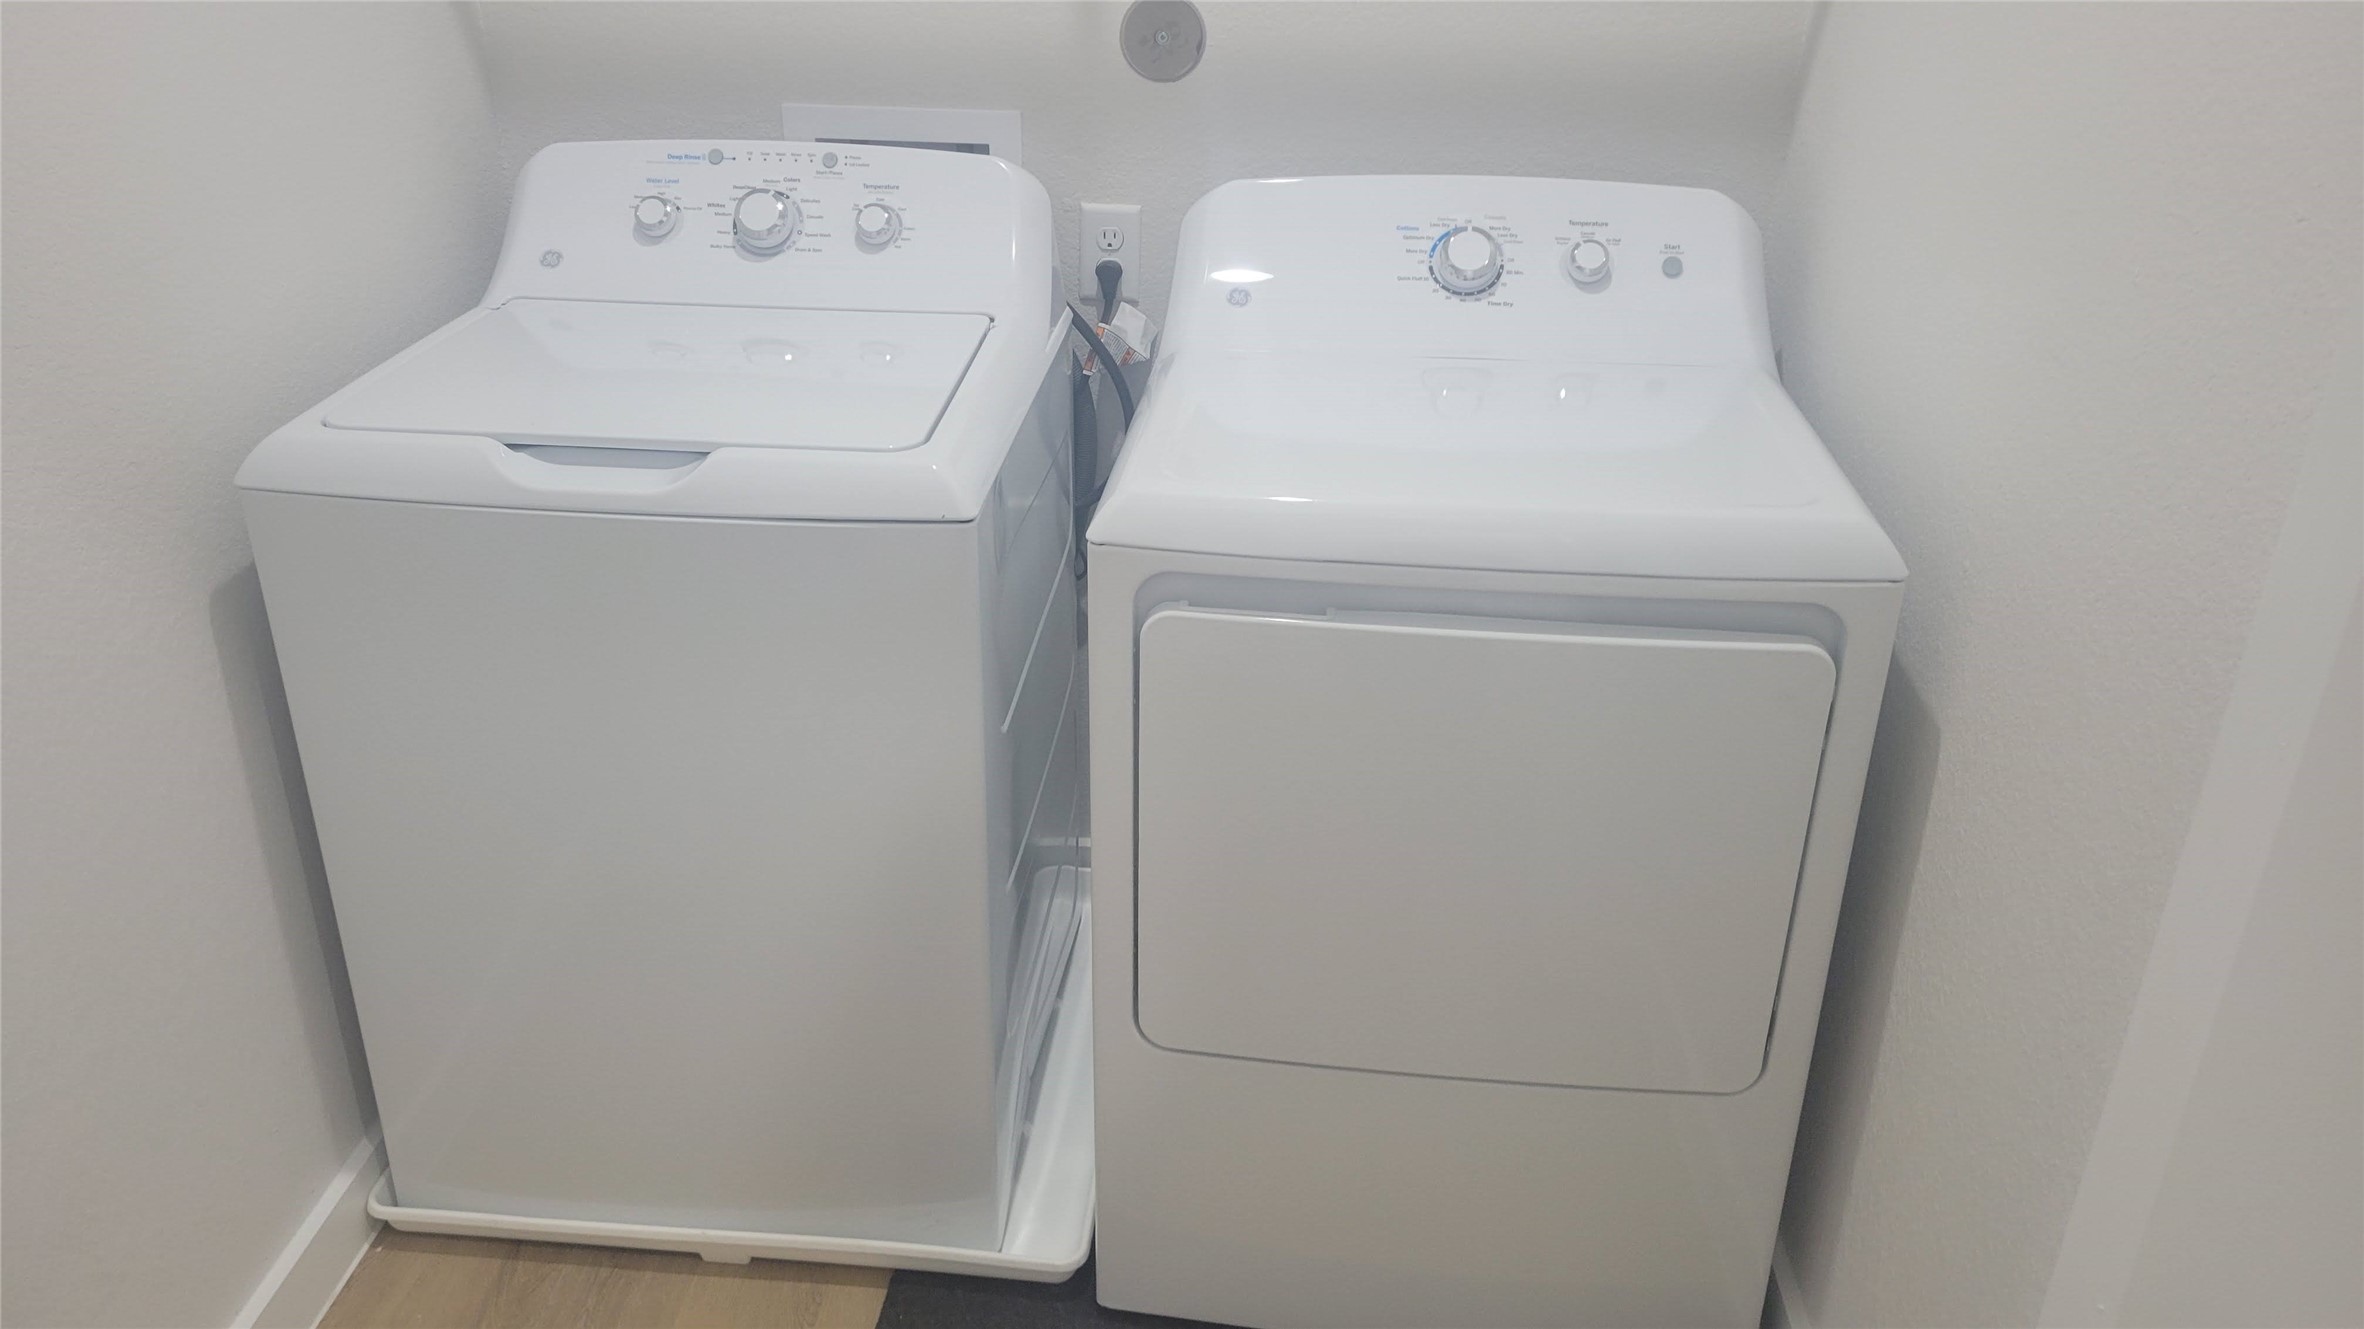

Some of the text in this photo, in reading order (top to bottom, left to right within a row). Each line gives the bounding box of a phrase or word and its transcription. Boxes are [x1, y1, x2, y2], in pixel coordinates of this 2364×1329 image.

[667, 153, 683, 161] Deep
[863, 183, 900, 191] Temperature
[1568, 219, 1609, 228] Temperature
